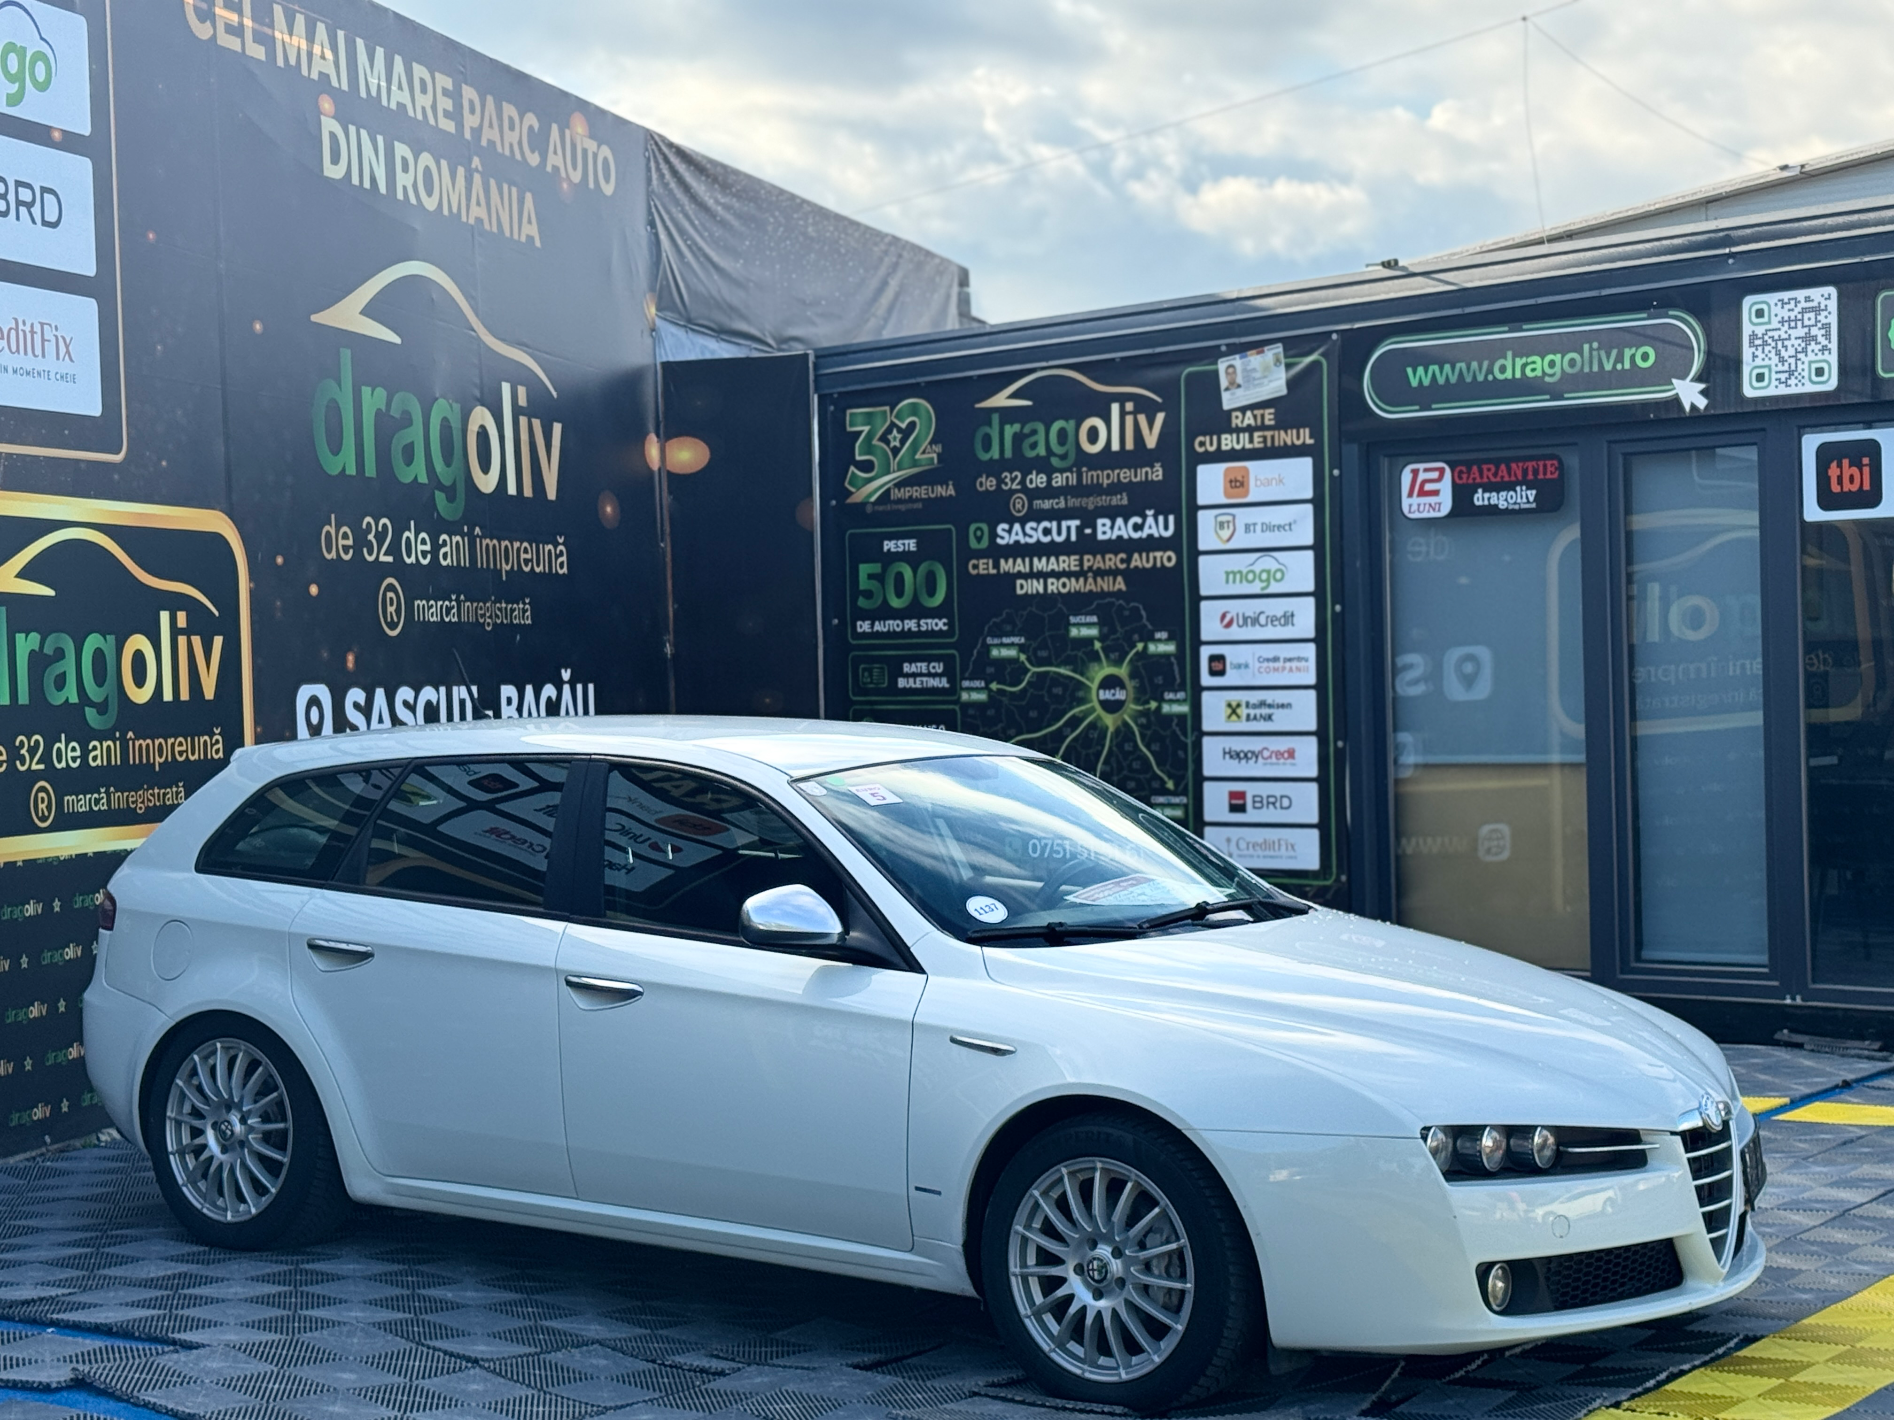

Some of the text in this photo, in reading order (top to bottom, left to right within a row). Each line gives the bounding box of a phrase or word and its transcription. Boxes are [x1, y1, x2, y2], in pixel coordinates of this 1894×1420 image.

[184, 0, 616, 196] CEL MAI MARE PARC AUTO
[320, 114, 542, 248] DIN ROMÂNIA
[1406, 342, 1656, 387] www.dragoliv.ro
[12, 366, 52, 380] MOMENTE
[55, 371, 77, 384] CHEIE
[1231, 408, 1276, 428] RATE
[312, 347, 563, 522] dragoliv
[974, 401, 1166, 468] dragoliv
[1194, 427, 1315, 452] CU BULETINUL
[976, 462, 1164, 491] de 32 de ani împreună
[1228, 474, 1285, 489] tbi bank
[1407, 459, 1560, 498] 12 GARANTIE
[1828, 456, 1871, 493] tbi
[890, 481, 956, 500] ÎMPREUNĂ
[1473, 485, 1537, 509] dragoliv
[1033, 496, 1066, 510] marcă
[1067, 492, 1128, 510] înregistrată
[1408, 501, 1443, 514] LUNI
[996, 519, 1081, 545] SASCUT
[1096, 509, 1175, 541] BACĂU
[1218, 520, 1231, 531] BT
[1244, 522, 1258, 534] BT
[321, 513, 568, 581] de 32 de ani împreună
[883, 539, 917, 552] PESTE
[968, 551, 1176, 575] CEL MAI MARE PARC AUTO
[857, 560, 948, 610] 500
[1016, 573, 1127, 595] DIN ROMÂNIA
[1224, 568, 1286, 591] mogo
[414, 594, 458, 622] marcă
[460, 597, 532, 631] înregistrată
[1236, 610, 1295, 628] UniCredit
[857, 618, 949, 632] DE AUTO PE STOC
[903, 662, 944, 674] RATE CU
[1229, 659, 1250, 671] bank
[1257, 655, 1309, 665] Credit pentru
[1257, 665, 1309, 674] COMPANII
[897, 677, 950, 689] BULETINUL
[1098, 686, 1127, 701] BACĂU
[1245, 700, 1293, 710] Raiffeisen
[1245, 713, 1275, 723] BANK
[15, 734, 46, 771] 32
[52, 733, 81, 769] de
[88, 732, 121, 767] ani
[126, 727, 224, 772] împreună
[1222, 747, 1296, 764] HappyCredit
[64, 786, 108, 813] marcă
[109, 782, 185, 814] înregistrată
[1252, 794, 1293, 811] BRD
[1028, 839, 1070, 859] 0751
[1235, 837, 1297, 853] CreditFix
[1, 899, 44, 921] dragoliv
[974, 902, 999, 916] 1137
[41, 943, 83, 966] dragoliv
[5, 1001, 48, 1024] dragoliv
[9, 1103, 52, 1127] dragoliv
